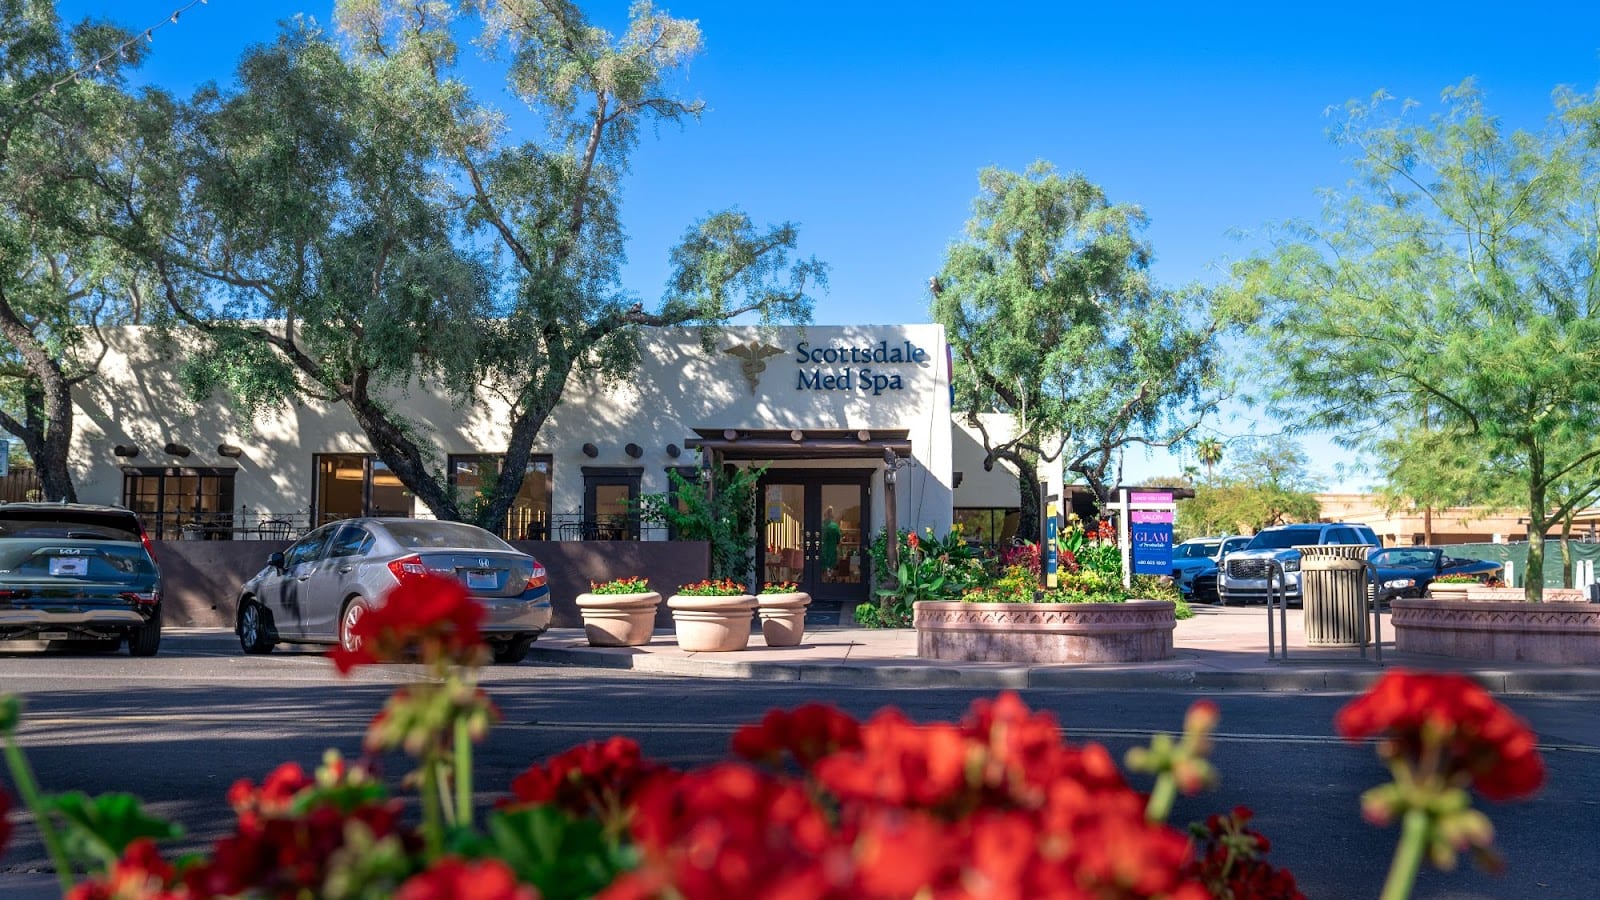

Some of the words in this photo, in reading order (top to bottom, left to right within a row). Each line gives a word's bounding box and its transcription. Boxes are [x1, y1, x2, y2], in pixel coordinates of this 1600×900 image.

[796, 341, 925, 364] Scottsdale
[796, 368, 853, 391] Med
[859, 368, 904, 396] Spa
[1135, 531, 1168, 543] GLAM
